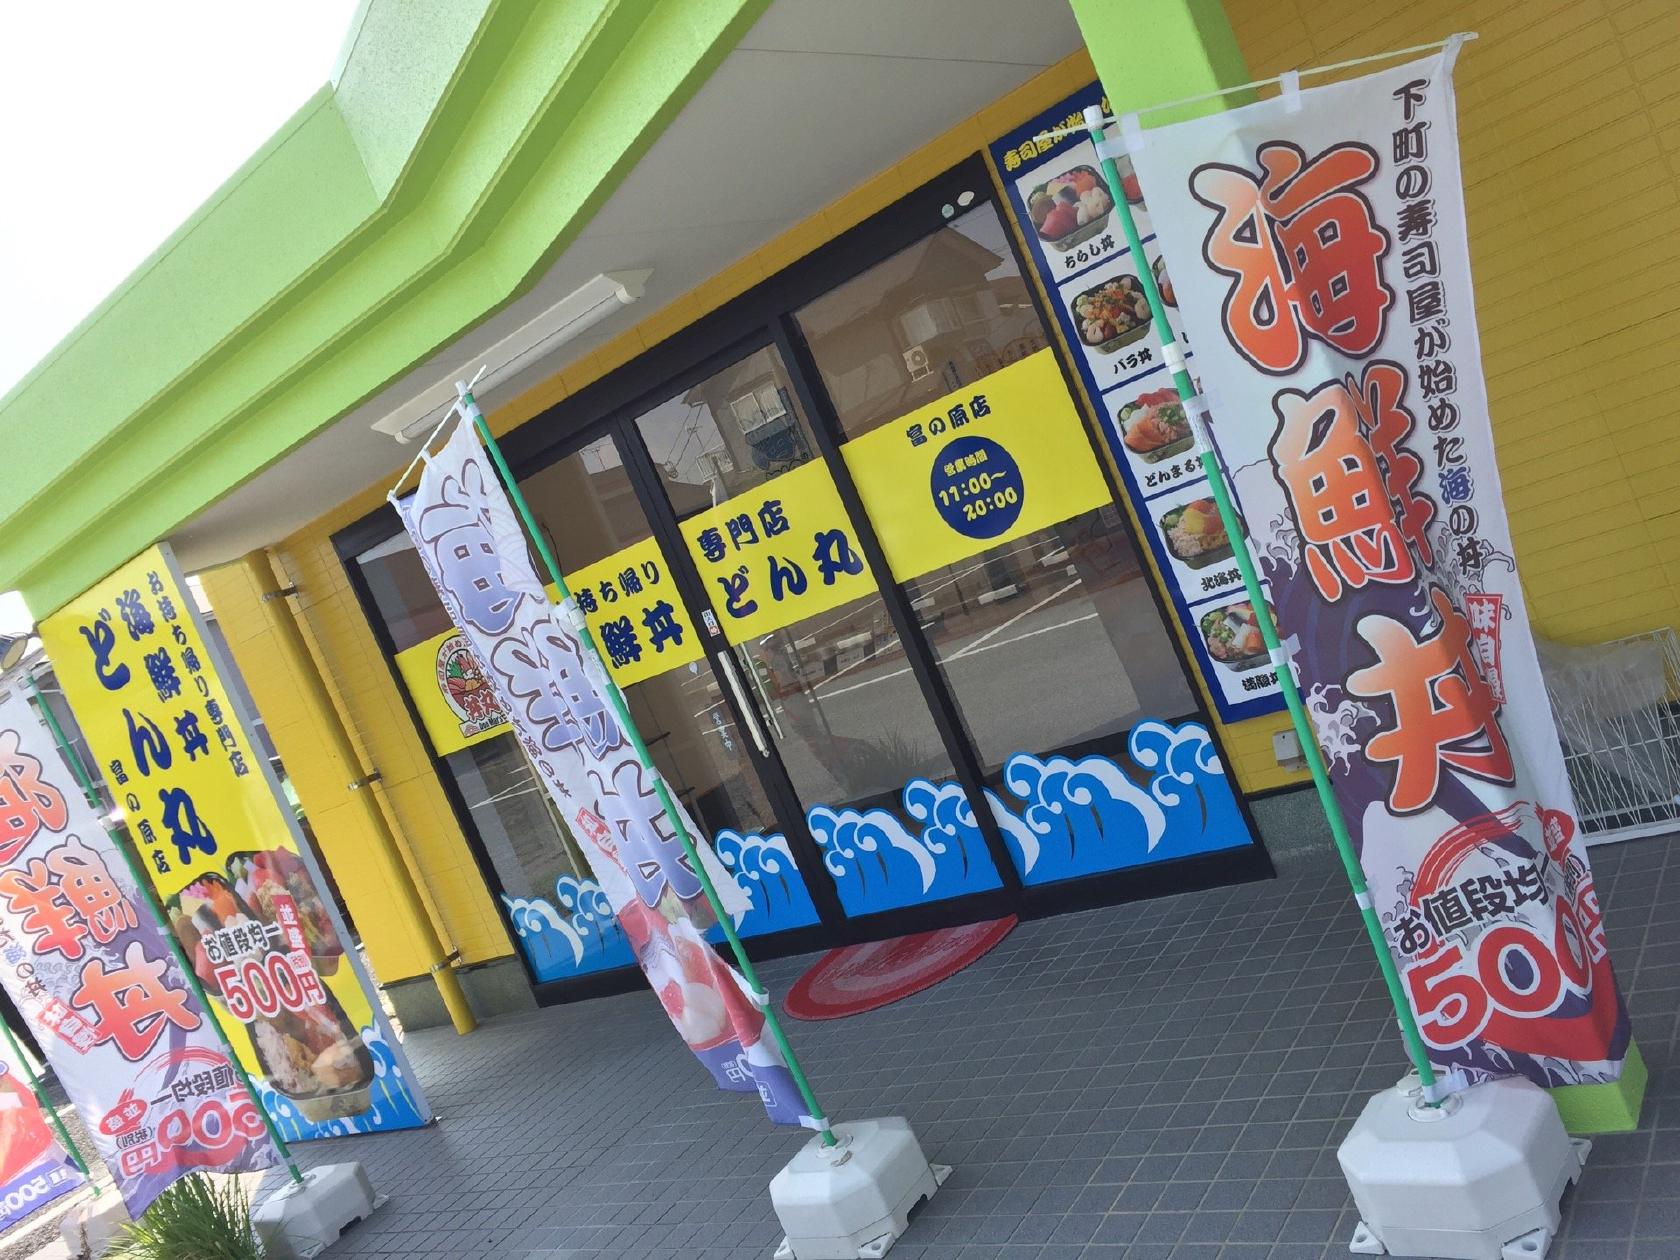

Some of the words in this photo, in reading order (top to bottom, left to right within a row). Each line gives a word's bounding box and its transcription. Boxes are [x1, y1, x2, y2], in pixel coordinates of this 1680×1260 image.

[1064, 234, 1115, 269] ちらし丼
[1392, 78, 1484, 576] 下町の寿司屋が始めた海の丼
[1113, 347, 1153, 375] バラ丼
[944, 448, 988, 477] 営業時間
[1188, 140, 1515, 817] 海鮮丼
[698, 499, 790, 563] 専門店
[963, 487, 1018, 521] 20:00
[574, 561, 660, 615] 持ち帰り
[718, 528, 864, 619] どん丸
[116, 588, 210, 762] 海鮮丼
[147, 571, 249, 778] お持ち帰り専門店
[79, 608, 217, 865] どん丸
[203, 923, 282, 962] お値段均一
[221, 952, 326, 1022] 500円
